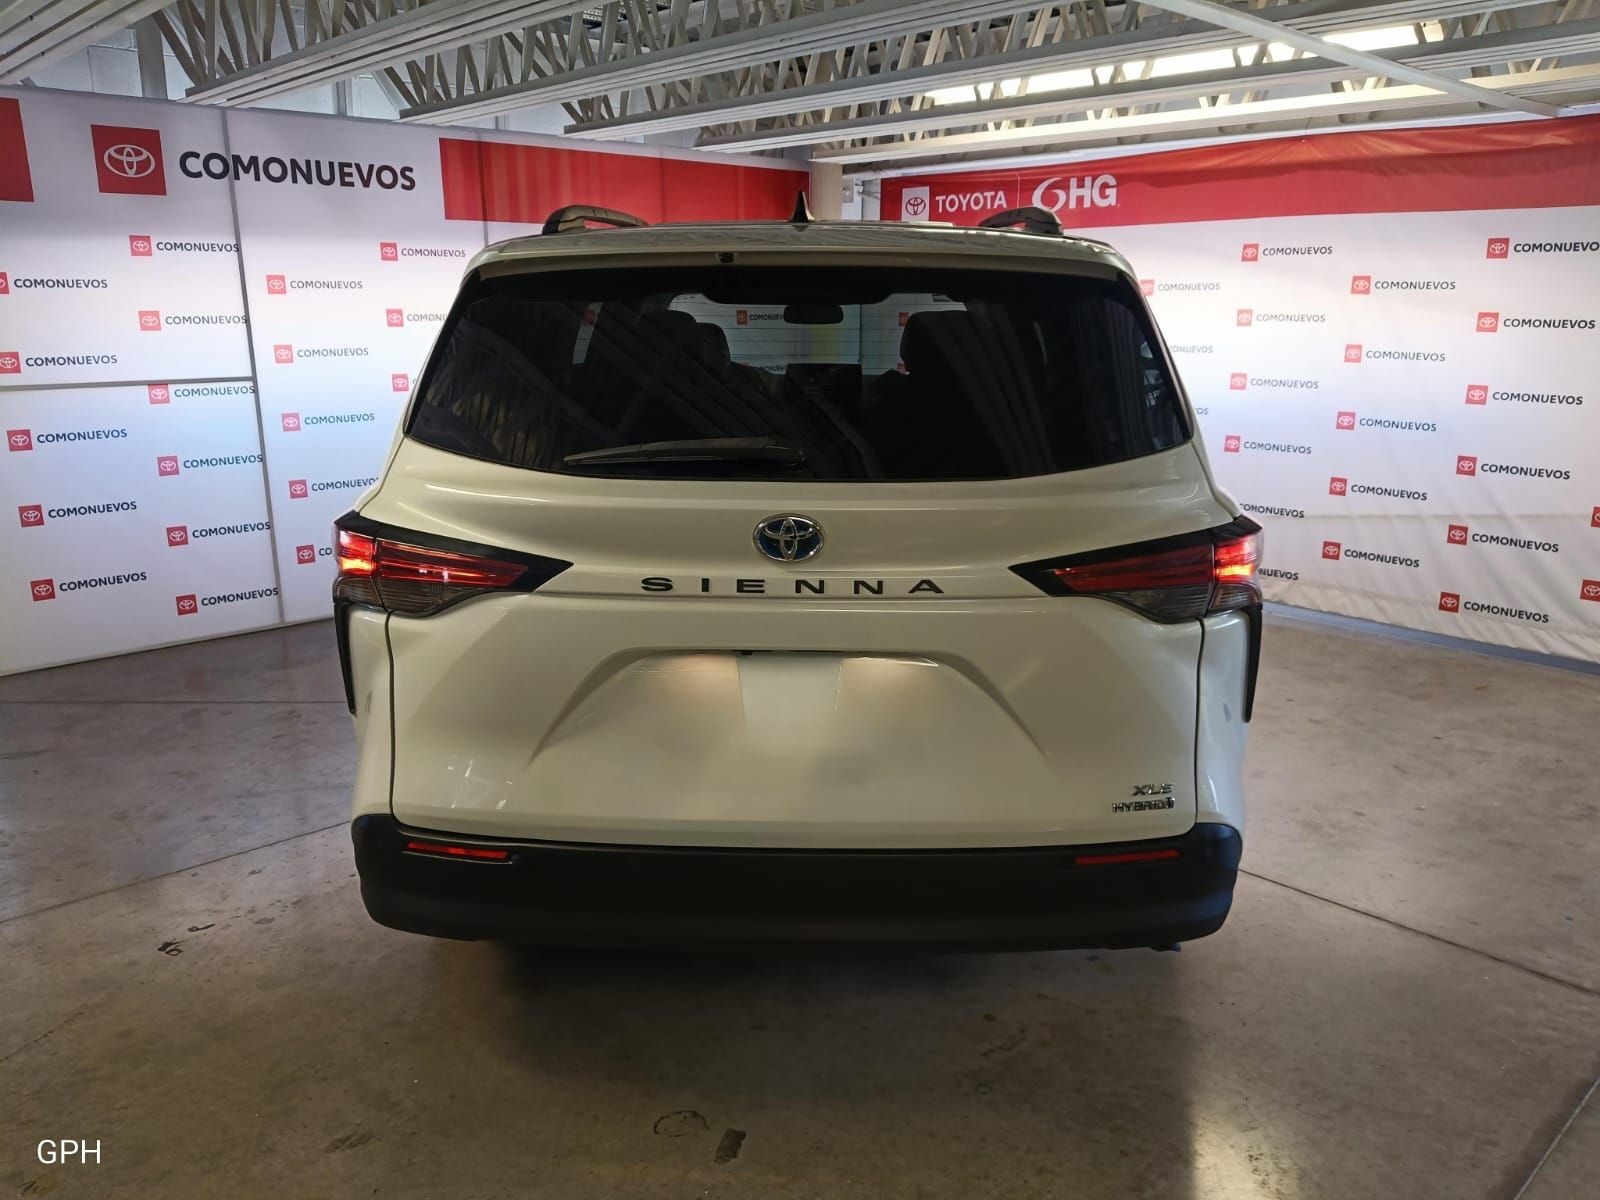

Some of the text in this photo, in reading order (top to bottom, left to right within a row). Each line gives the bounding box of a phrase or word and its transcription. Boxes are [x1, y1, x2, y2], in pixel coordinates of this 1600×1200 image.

[180, 151, 416, 191] COMONUEVOS
[936, 190, 1007, 213] TOYOTA
[156, 240, 239, 253] COMONUEVOS
[401, 247, 466, 258] COMONUEVOS
[1262, 245, 1333, 257] COMONUEVOS
[13, 277, 108, 290] COMONUEVOS
[290, 279, 363, 290] COMONUEVOS
[1157, 281, 1220, 292] COMONUEVOS
[1374, 280, 1456, 291] COMONUEVOS
[165, 314, 247, 326] COMONUEVOS
[1256, 313, 1326, 324] COMONUEVOS
[1503, 318, 1596, 330] COMONUEVOS
[297, 346, 369, 358] COMONUEVOS
[1169, 345, 1214, 354] ONUEVOS
[1366, 349, 1446, 362] COMONUEVOS
[25, 354, 118, 368] COMONUEVOS
[1250, 377, 1319, 389] COMONUEVOS
[174, 385, 256, 399] COMONUEVOS
[1492, 391, 1583, 405] COMONUEVOS
[304, 413, 375, 425] COMONUEVOS
[1359, 417, 1437, 432] COMONUEVOS
[36, 428, 128, 444] COMONUEVOS
[1243, 441, 1312, 454] COMONUEVOS
[183, 454, 264, 470] COMONUEVOS
[1480, 463, 1571, 480] COMONUEVOS
[311, 477, 379, 492] COMONUEVO
[1350, 483, 1428, 501] COMONUEVOS
[48, 500, 138, 519] COMONUEVOS
[1240, 503, 1305, 518] OMONUEVOS
[192, 521, 271, 539] COMONUEVOS
[1471, 533, 1559, 553] COMONUEVOS
[1344, 548, 1420, 568] COMONUEVOS
[1258, 568, 1299, 580] NUEVOS
[59, 571, 148, 593] COMONUEVOS
[641, 577, 945, 595] SIENNA
[200, 587, 280, 607] COMONUEVOS
[1463, 601, 1550, 624] COMONUEVOS
[1132, 784, 1173, 796] XLE
